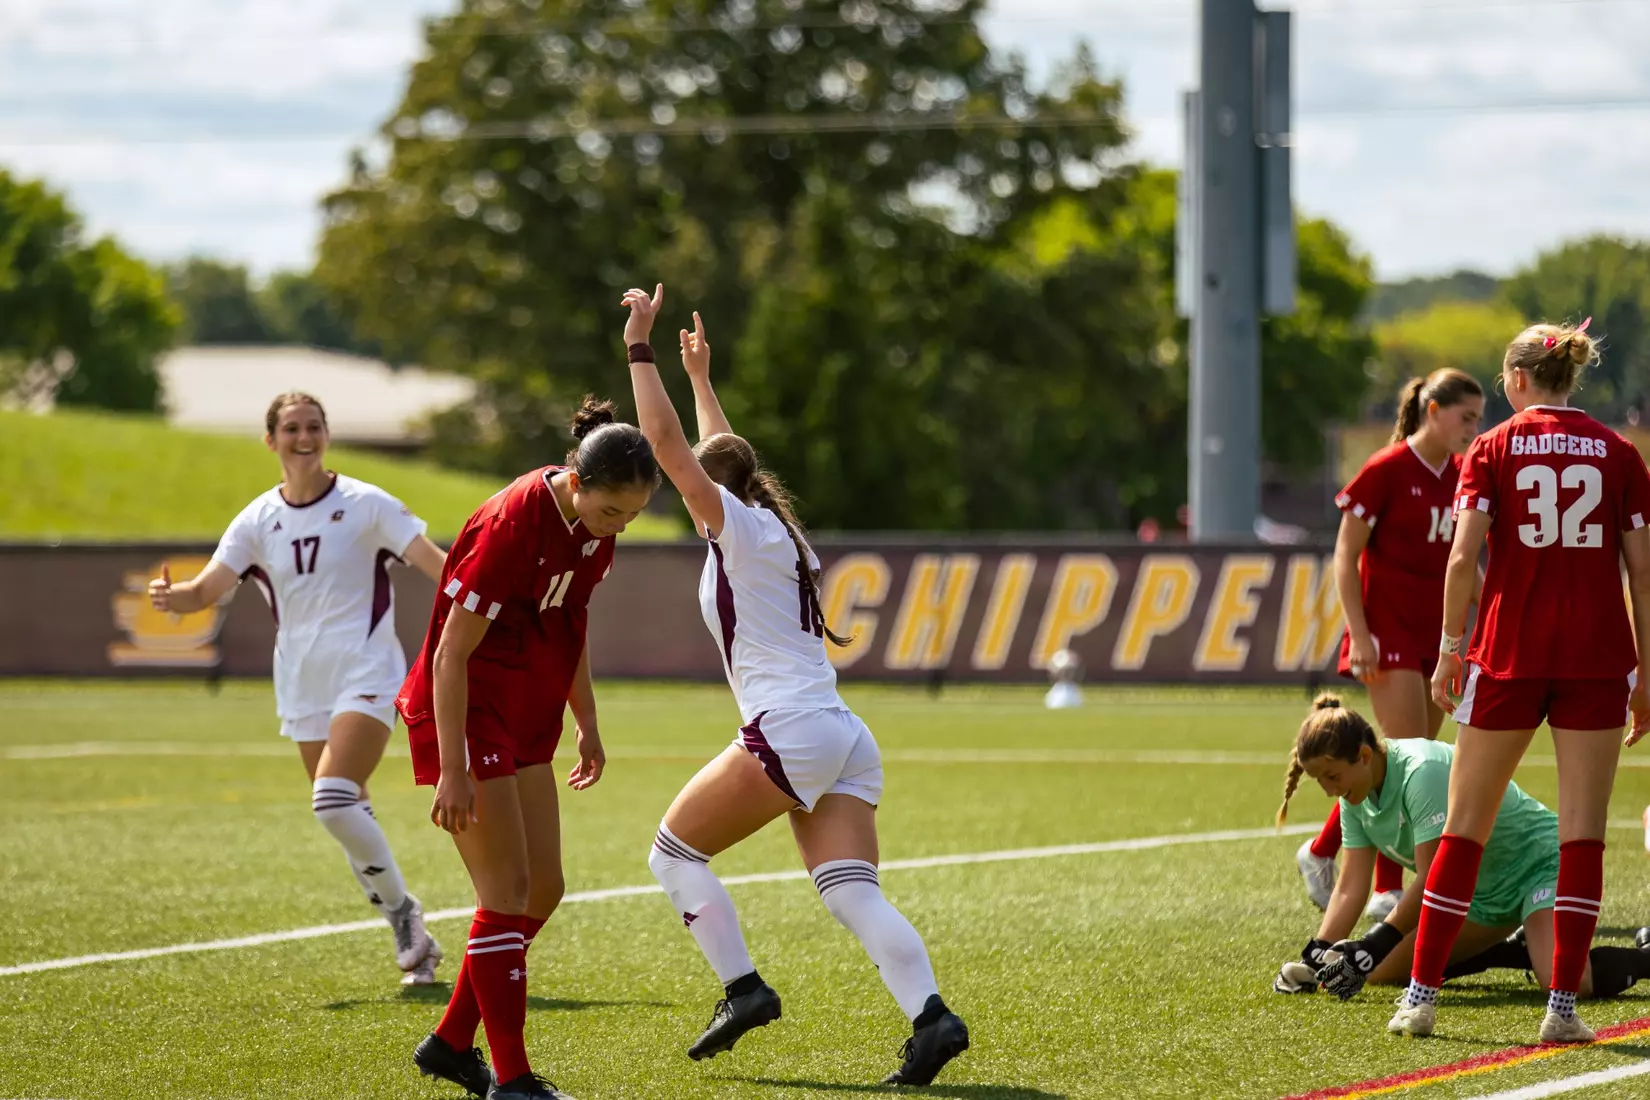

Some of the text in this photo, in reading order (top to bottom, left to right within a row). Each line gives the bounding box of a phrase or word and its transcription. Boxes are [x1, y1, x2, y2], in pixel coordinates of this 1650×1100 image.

[1511, 433, 1607, 458] BADGERS
[1427, 506, 1454, 543] 14
[1516, 464, 1603, 548] 32
[291, 535, 320, 575] 17
[540, 570, 575, 613] 11
